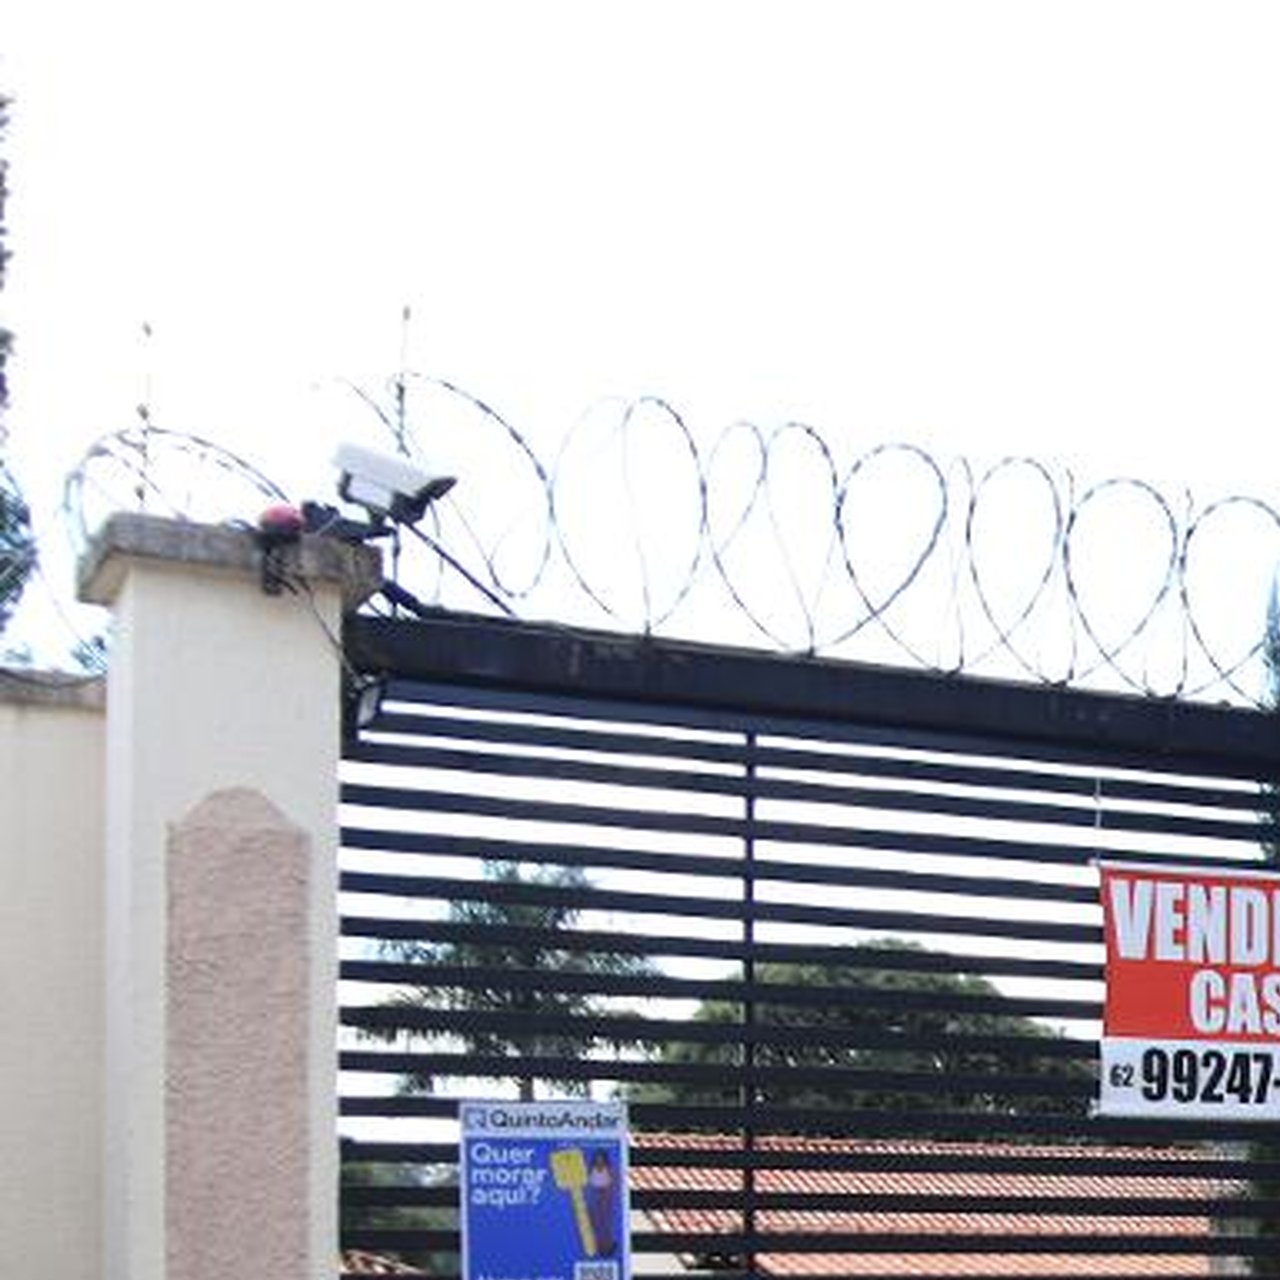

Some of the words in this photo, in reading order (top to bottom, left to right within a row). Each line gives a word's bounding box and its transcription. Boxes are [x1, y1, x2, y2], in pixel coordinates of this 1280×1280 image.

[1109, 1064, 1134, 1088] 62
[470, 1143, 535, 1164] Quer
[471, 1168, 548, 1185] morar
[471, 1188, 542, 1209] aqui?
